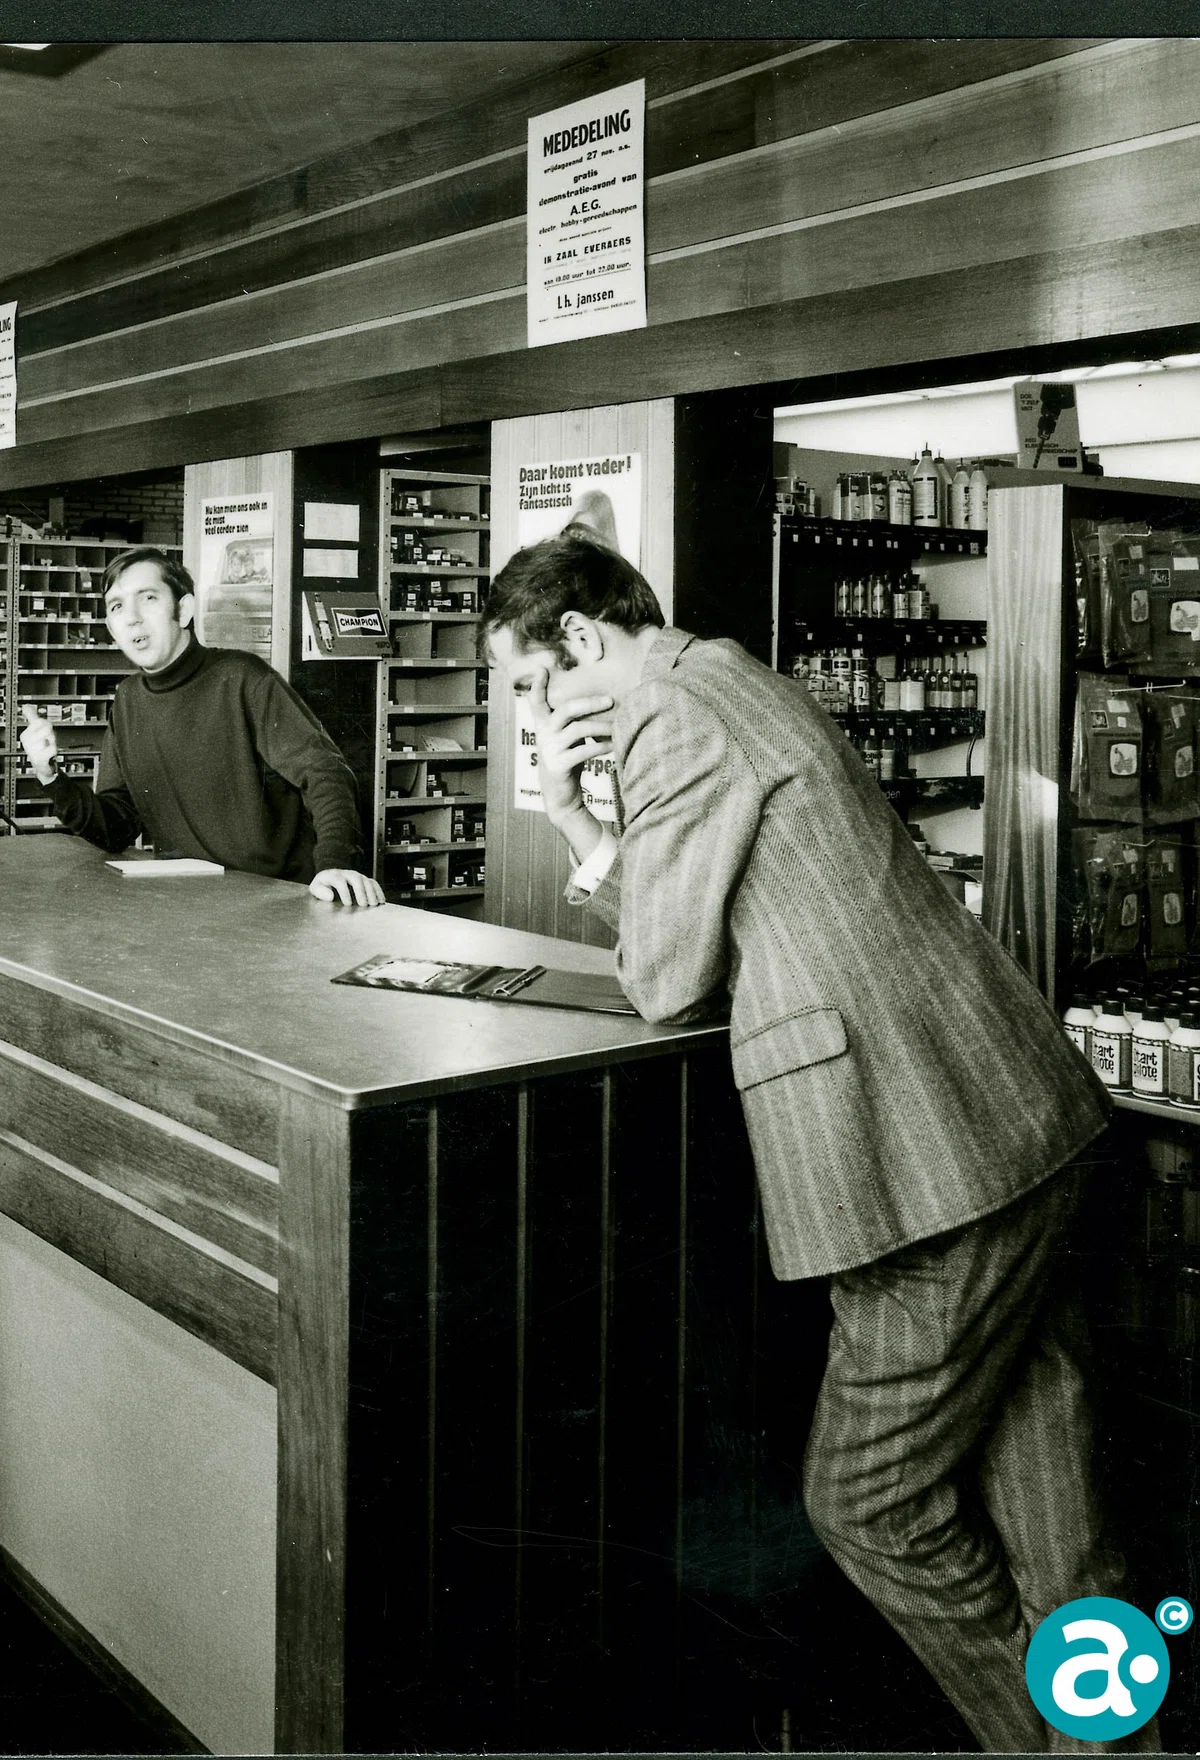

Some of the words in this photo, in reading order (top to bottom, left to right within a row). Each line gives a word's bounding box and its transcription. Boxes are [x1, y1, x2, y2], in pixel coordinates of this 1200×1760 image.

[543, 109, 631, 157] MEDEDELING
[587, 150, 598, 161] 27
[573, 169, 598, 184] gratis
[539, 177, 616, 206] demonstratie-avond
[622, 173, 637, 183] van
[570, 199, 601, 216] A.E.G.
[556, 249, 578, 261] ZAAL
[584, 236, 631, 255] EVERAERS
[586, 268, 596, 276] tot
[576, 289, 614, 308] janssen
[519, 467, 547, 483] Daar
[549, 464, 584, 480] komt
[519, 484, 539, 499] Zijn
[540, 482, 561, 495] licht
[562, 482, 571, 493] is
[213, 505, 223, 514] kan
[224, 504, 237, 513] men
[237, 503, 248, 512] ons
[249, 501, 260, 511] ook
[519, 495, 572, 510] fantastisch
[205, 516, 212, 525] de
[213, 516, 225, 525] mist
[205, 525, 216, 535] veel
[216, 525, 235, 534] eerder
[236, 524, 249, 533] zien
[340, 618, 379, 626] CHAMPION
